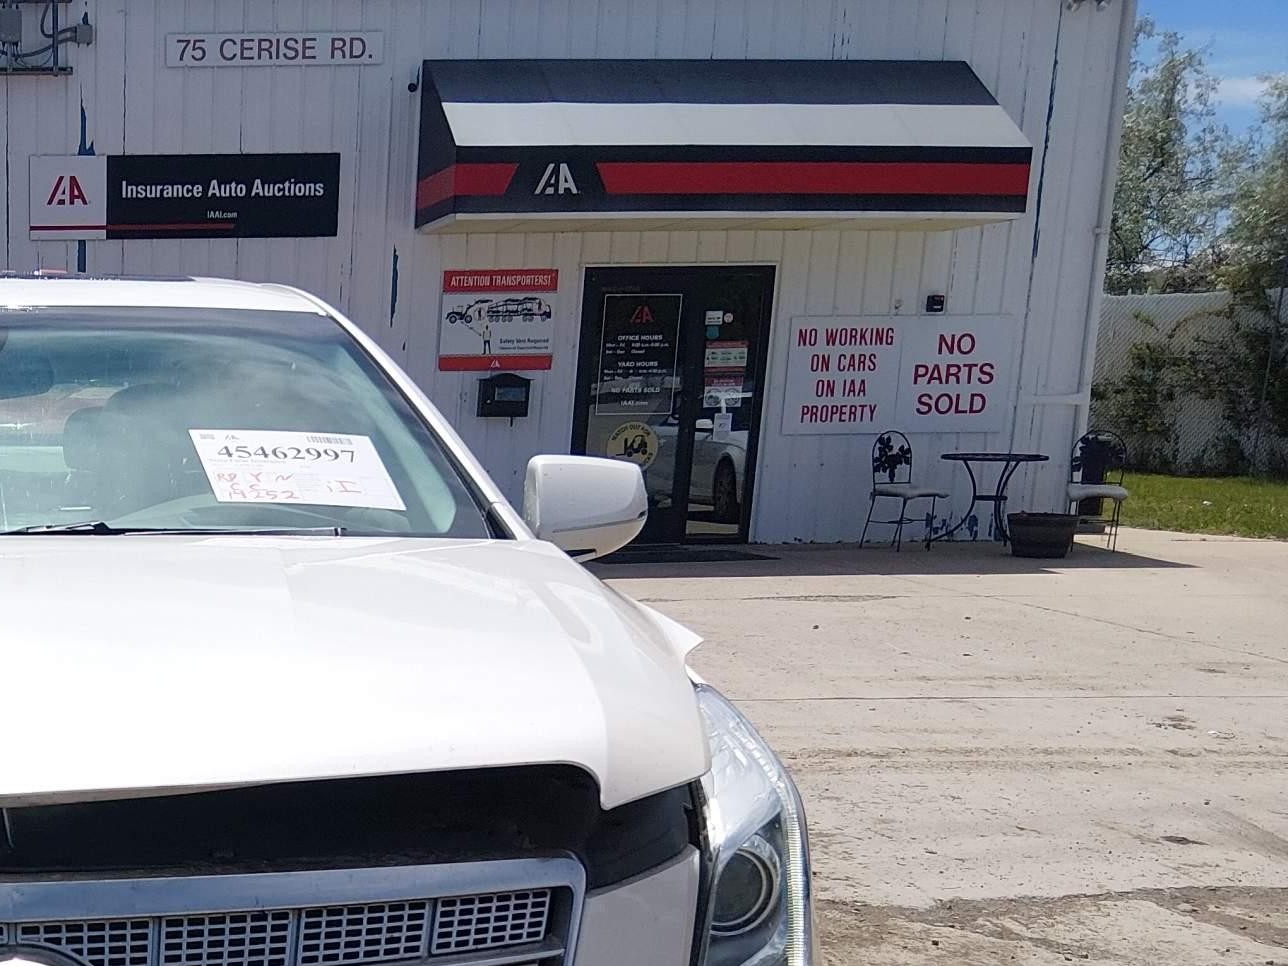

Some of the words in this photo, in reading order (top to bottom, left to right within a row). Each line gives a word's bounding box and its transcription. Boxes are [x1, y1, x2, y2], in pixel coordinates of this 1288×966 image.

[175, 38, 207, 61] 75
[219, 37, 317, 61] CERISE
[330, 36, 373, 60] RD.
[121, 179, 203, 200] Insurance
[207, 178, 247, 198] Auto
[250, 177, 325, 198] Auctions
[451, 275, 491, 287] ATTENTION
[492, 274, 552, 287] TRANSPORTERS!
[797, 328, 818, 347] NO
[825, 327, 895, 347] WORKING
[937, 333, 976, 355] NO
[810, 353, 831, 372] ON
[837, 353, 877, 372] CARS
[913, 362, 995, 385] PARTS
[815, 379, 836, 398] ON
[842, 378, 867, 397] IAA
[800, 404, 878, 424] PROPERTY
[915, 393, 987, 416] SOLD
[217, 445, 356, 463] 45462997
